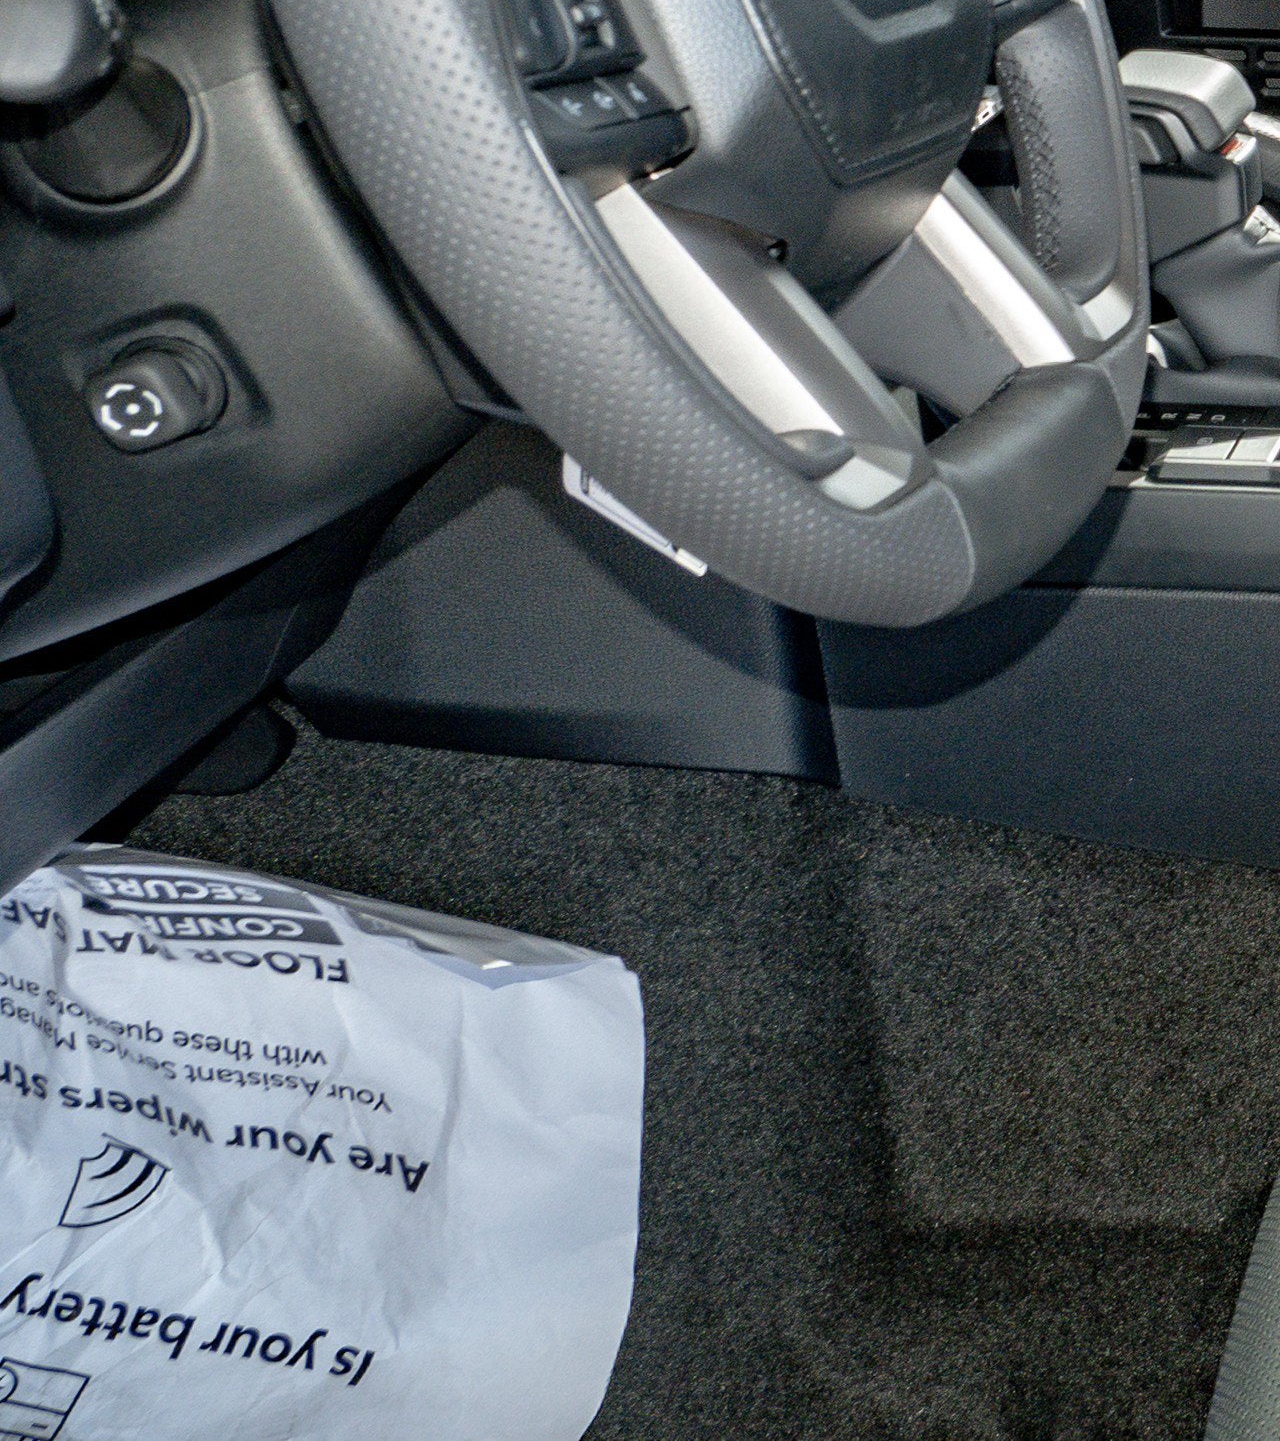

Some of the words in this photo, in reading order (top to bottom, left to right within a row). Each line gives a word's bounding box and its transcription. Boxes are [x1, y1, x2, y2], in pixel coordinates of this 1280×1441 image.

[190, 949, 350, 983] FLOOR
[172, 1030, 255, 1061] these
[263, 1044, 328, 1067] with
[185, 1064, 320, 1098] Assistant
[327, 1082, 392, 1113] Your
[59, 1085, 214, 1143] wipers
[225, 1124, 336, 1164] your
[348, 1144, 430, 1193] Are
[0, 1272, 197, 1360] battery
[200, 1321, 329, 1370] your
[328, 1344, 375, 1387] Is
